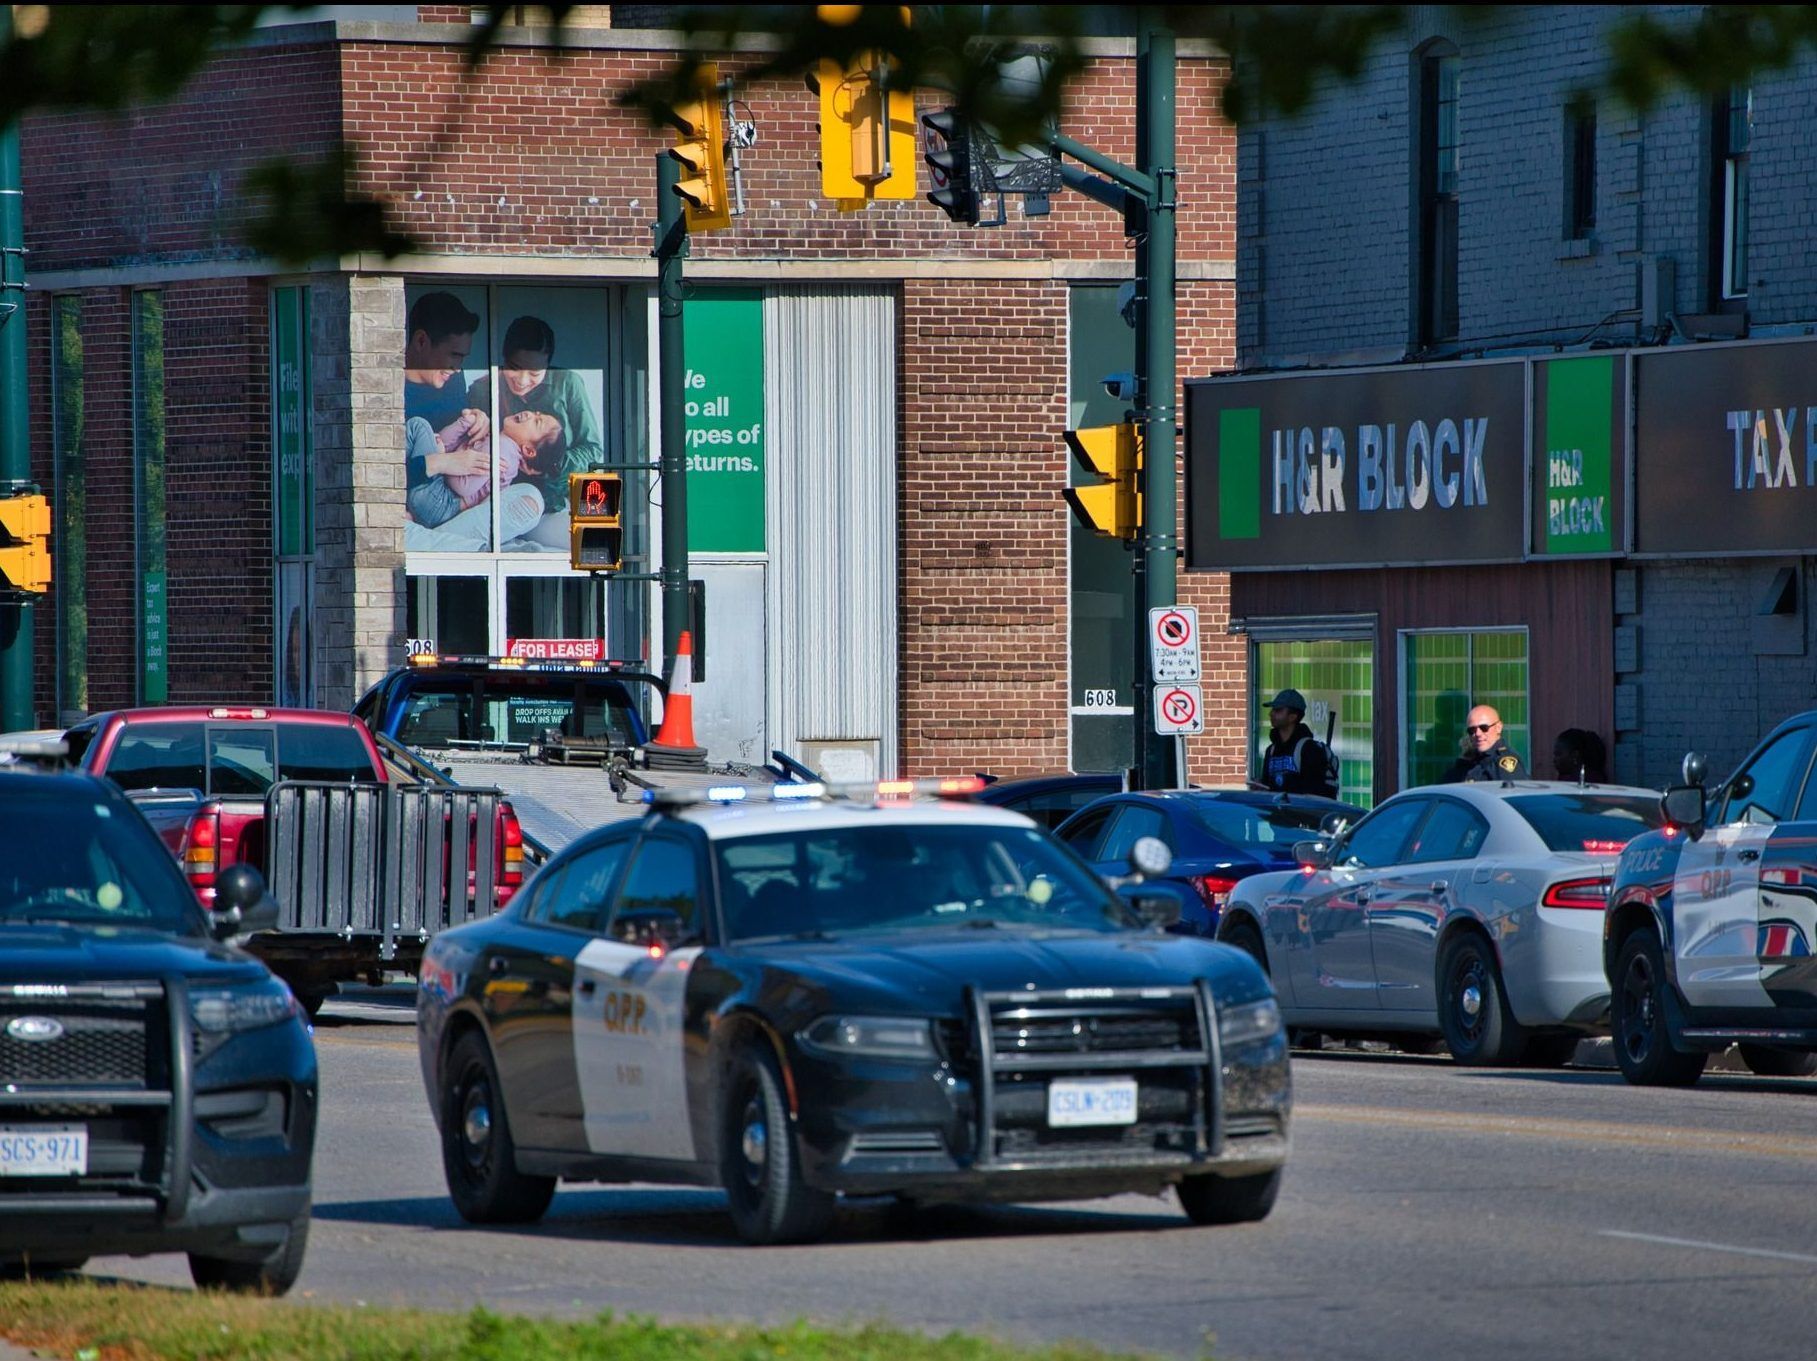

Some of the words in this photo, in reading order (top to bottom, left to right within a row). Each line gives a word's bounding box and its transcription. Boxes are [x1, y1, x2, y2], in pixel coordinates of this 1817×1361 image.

[281, 363, 299, 392] File
[281, 403, 299, 433] wit
[685, 401, 700, 417] o
[703, 396, 729, 417] all
[685, 429, 733, 448] ypes
[737, 424, 760, 445] of
[1727, 407, 1797, 490] TAX
[685, 454, 759, 472] eturns.
[1272, 425, 1346, 514] H&R
[1358, 417, 1489, 511] BLOCK
[1549, 449, 1583, 488] H&R
[1549, 496, 1605, 536] BLOCK
[518, 644, 546, 658] FOR
[550, 643, 593, 658] LEASE
[1086, 691, 1114, 706] 608
[515, 708, 534, 716] DROP
[535, 708, 552, 716] OFFS
[1311, 702, 1329, 722] tax
[1624, 846, 1663, 874] POLICE
